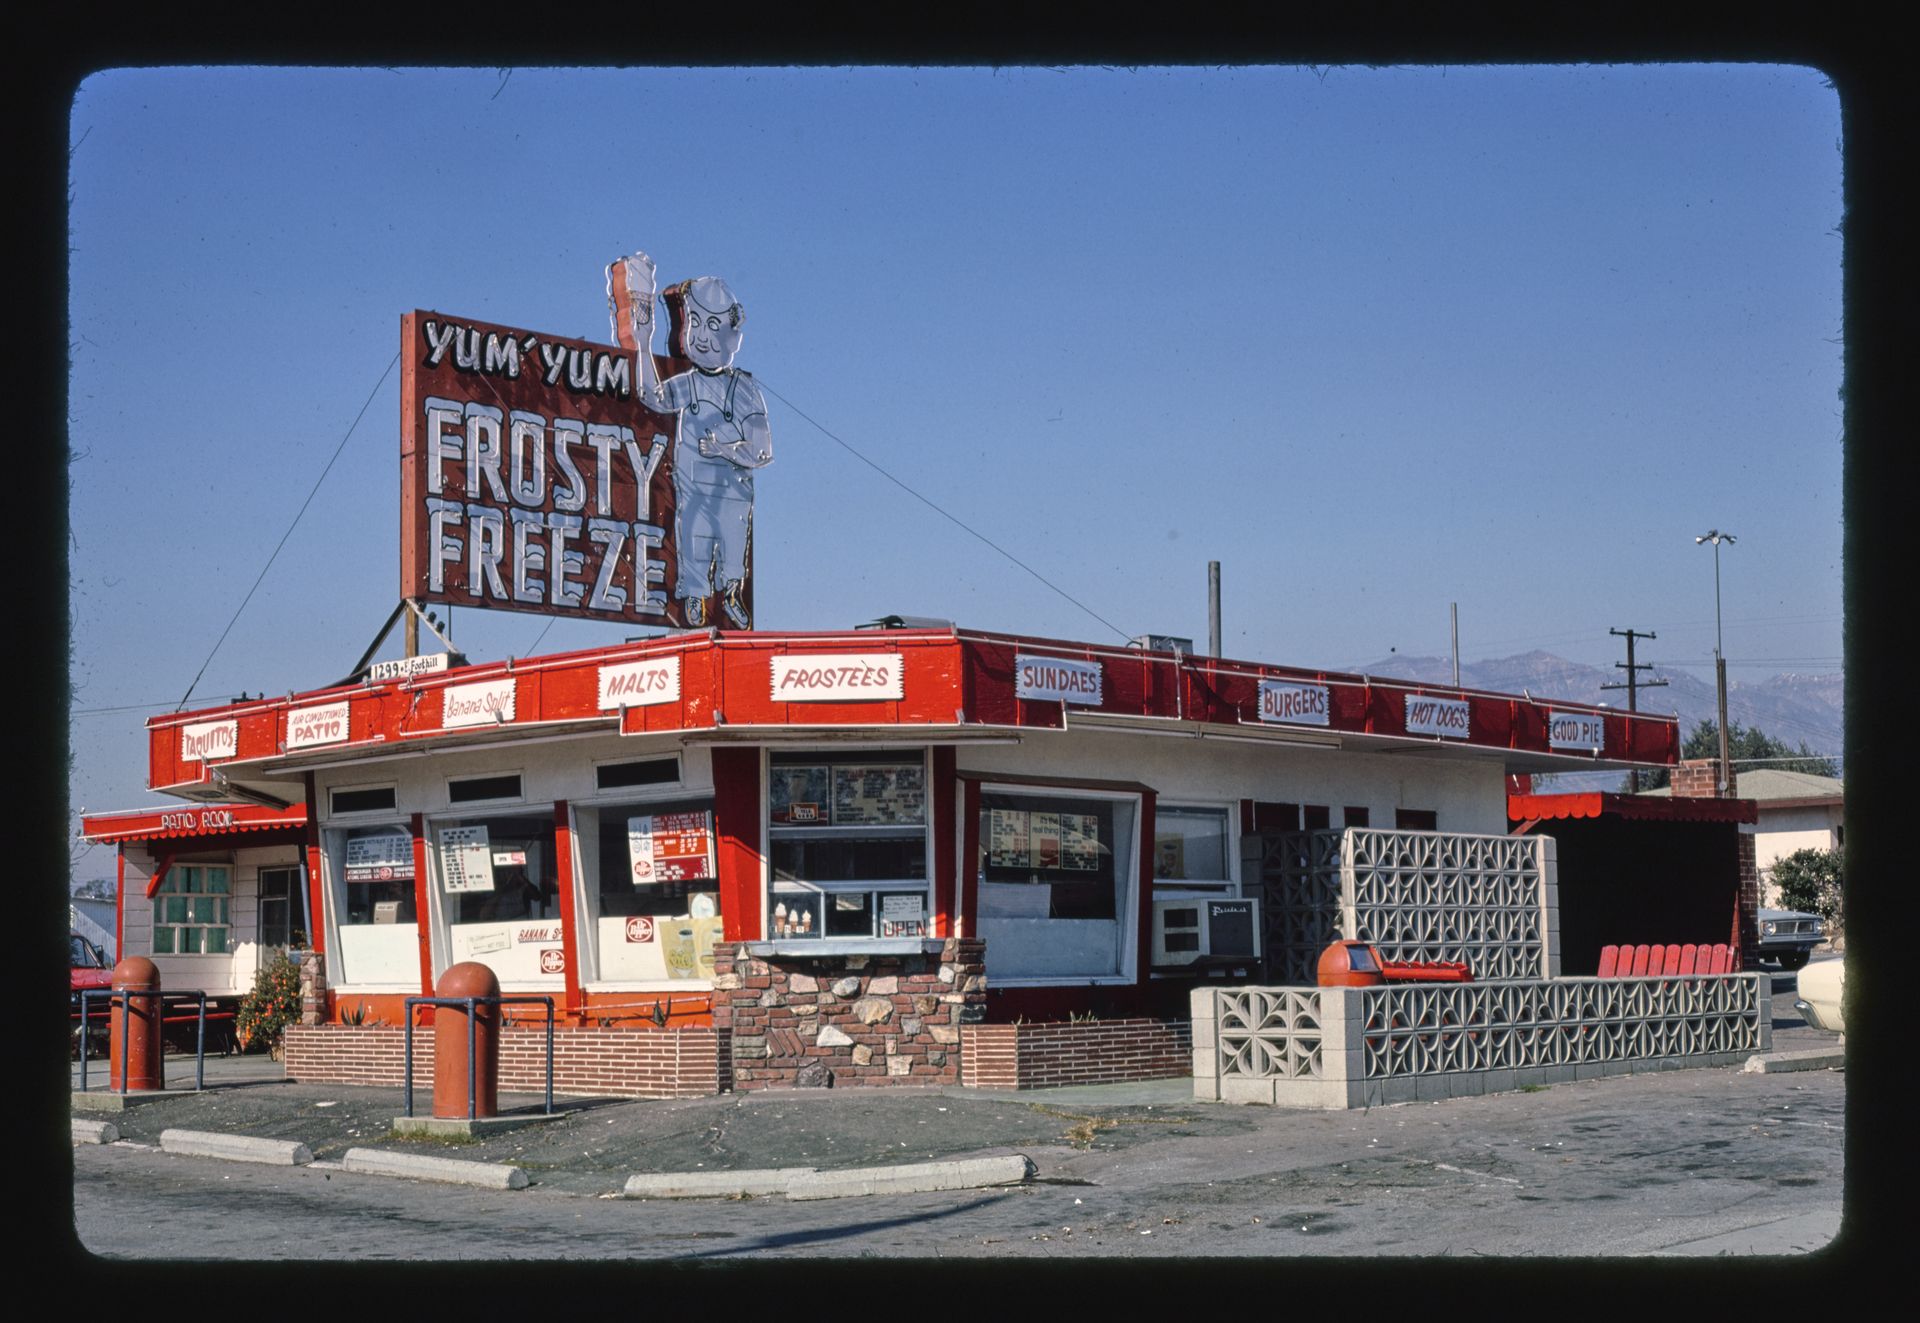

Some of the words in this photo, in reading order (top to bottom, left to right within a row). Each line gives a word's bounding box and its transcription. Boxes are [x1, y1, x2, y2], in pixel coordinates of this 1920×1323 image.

[541, 342, 631, 397] YUM
[424, 396, 668, 521] FROSTY
[425, 497, 668, 616] FREEZE
[374, 661, 399, 679] 1299
[410, 656, 438, 672] Foothill
[781, 666, 888, 689] FROSTEES
[607, 668, 669, 697] MALTS
[1023, 666, 1097, 693] SUNDAES
[447, 694, 483, 718] Banana
[484, 691, 511, 716] Split
[1264, 687, 1325, 717] BURGERS
[292, 715, 305, 726] AIR
[1411, 703, 1435, 725] HOT
[1436, 704, 1466, 729] DOGS
[185, 726, 234, 756] TAQUITOS
[295, 721, 341, 743] PATIO
[1552, 720, 1578, 741] GOOD
[1582, 721, 1599, 742] PIE
[518, 928, 549, 940] BANANA
[630, 924, 652, 939] Pepper
[637, 920, 647, 929] Dr
[884, 919, 927, 937] OPEN
[551, 952, 561, 961] Dr
